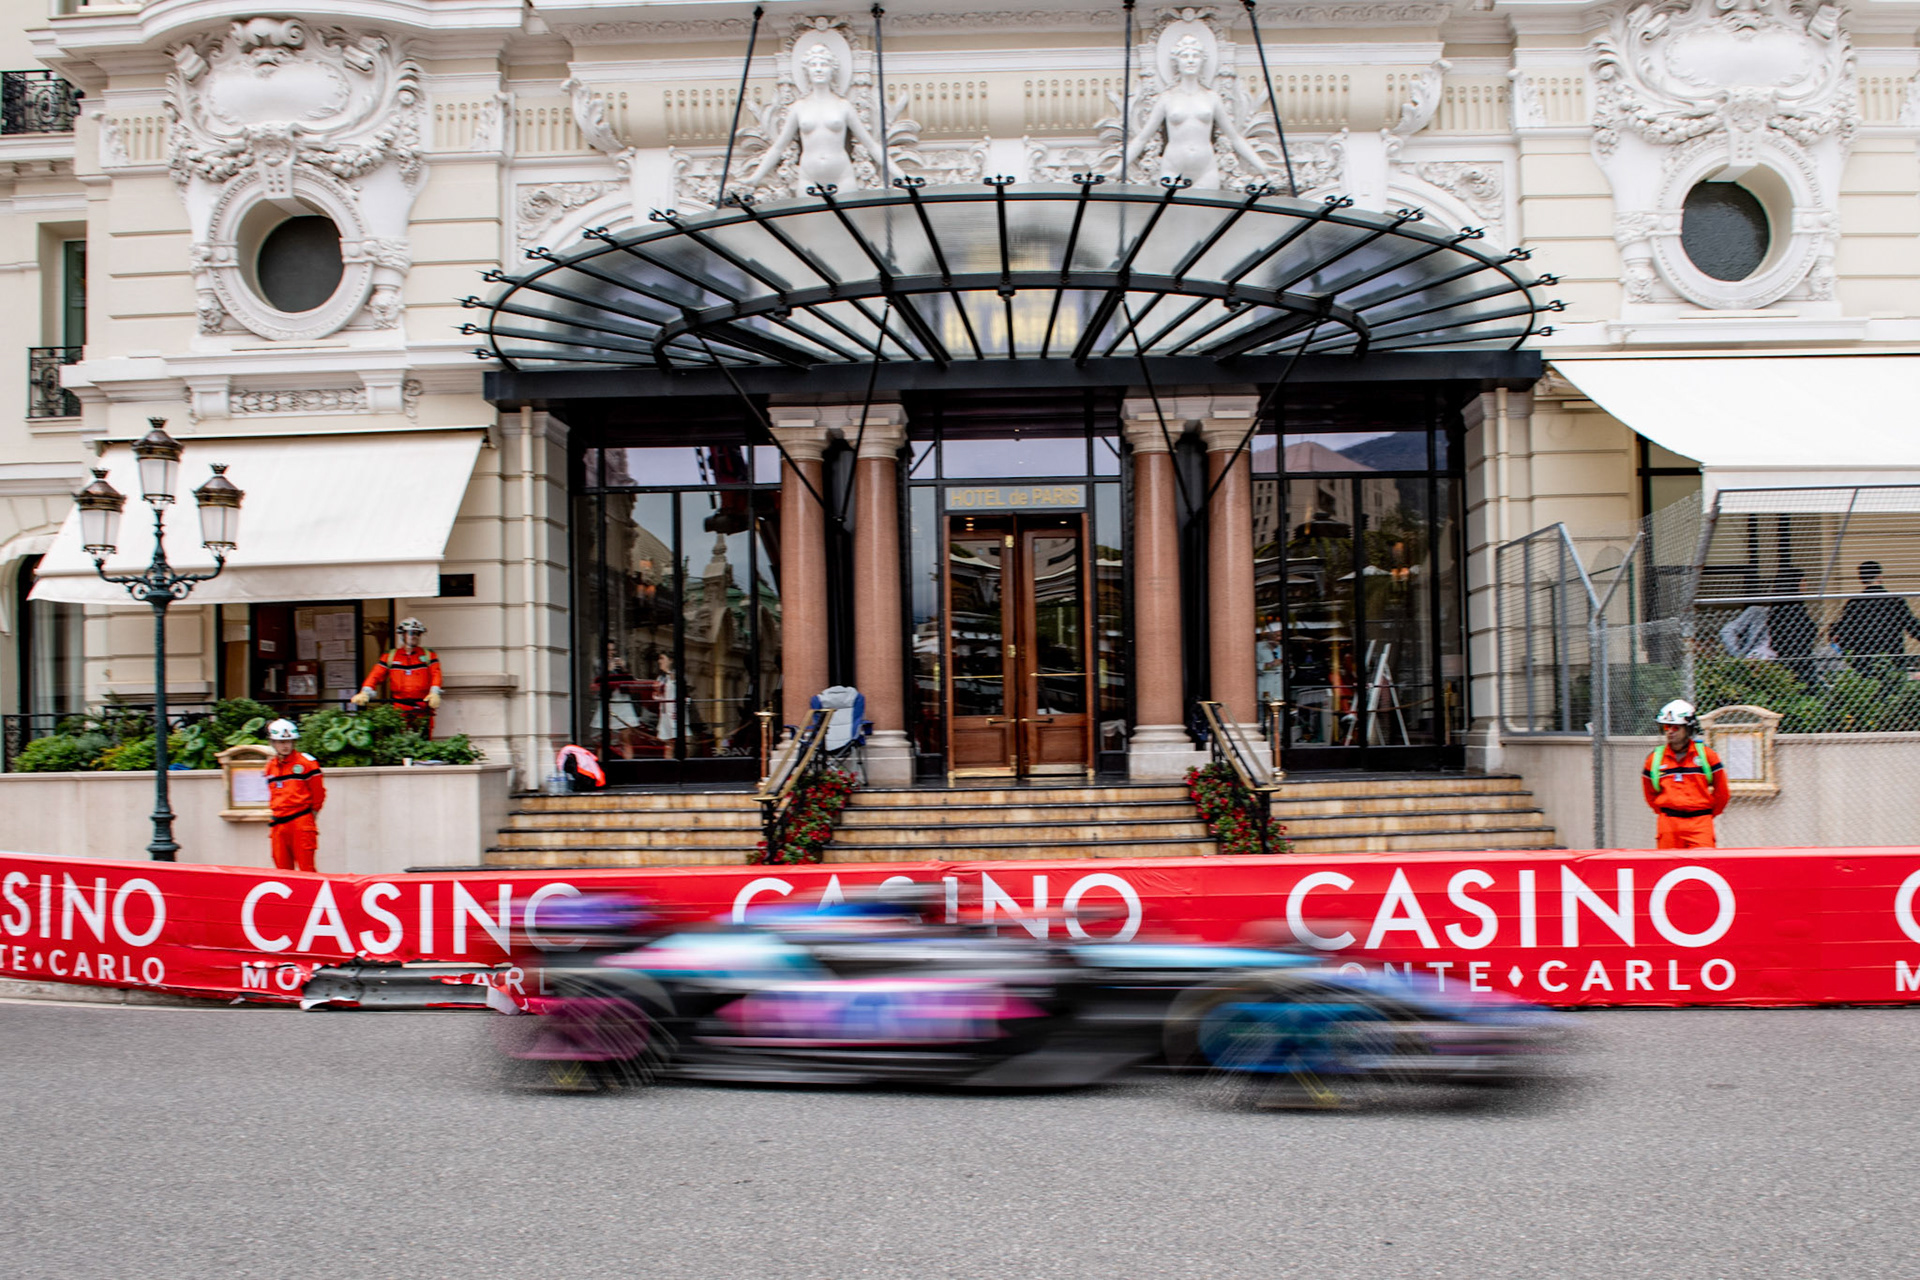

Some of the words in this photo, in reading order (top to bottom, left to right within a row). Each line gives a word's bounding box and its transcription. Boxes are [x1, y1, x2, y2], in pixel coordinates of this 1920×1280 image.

[951, 489, 1006, 507] HOTEL
[1009, 489, 1028, 505] de
[1032, 487, 1080, 505] PARIS
[0, 871, 166, 947] SINO
[1286, 864, 1736, 950] CASINO
[49, 949, 165, 985] CARLO
[1538, 958, 1736, 992] CARLO
